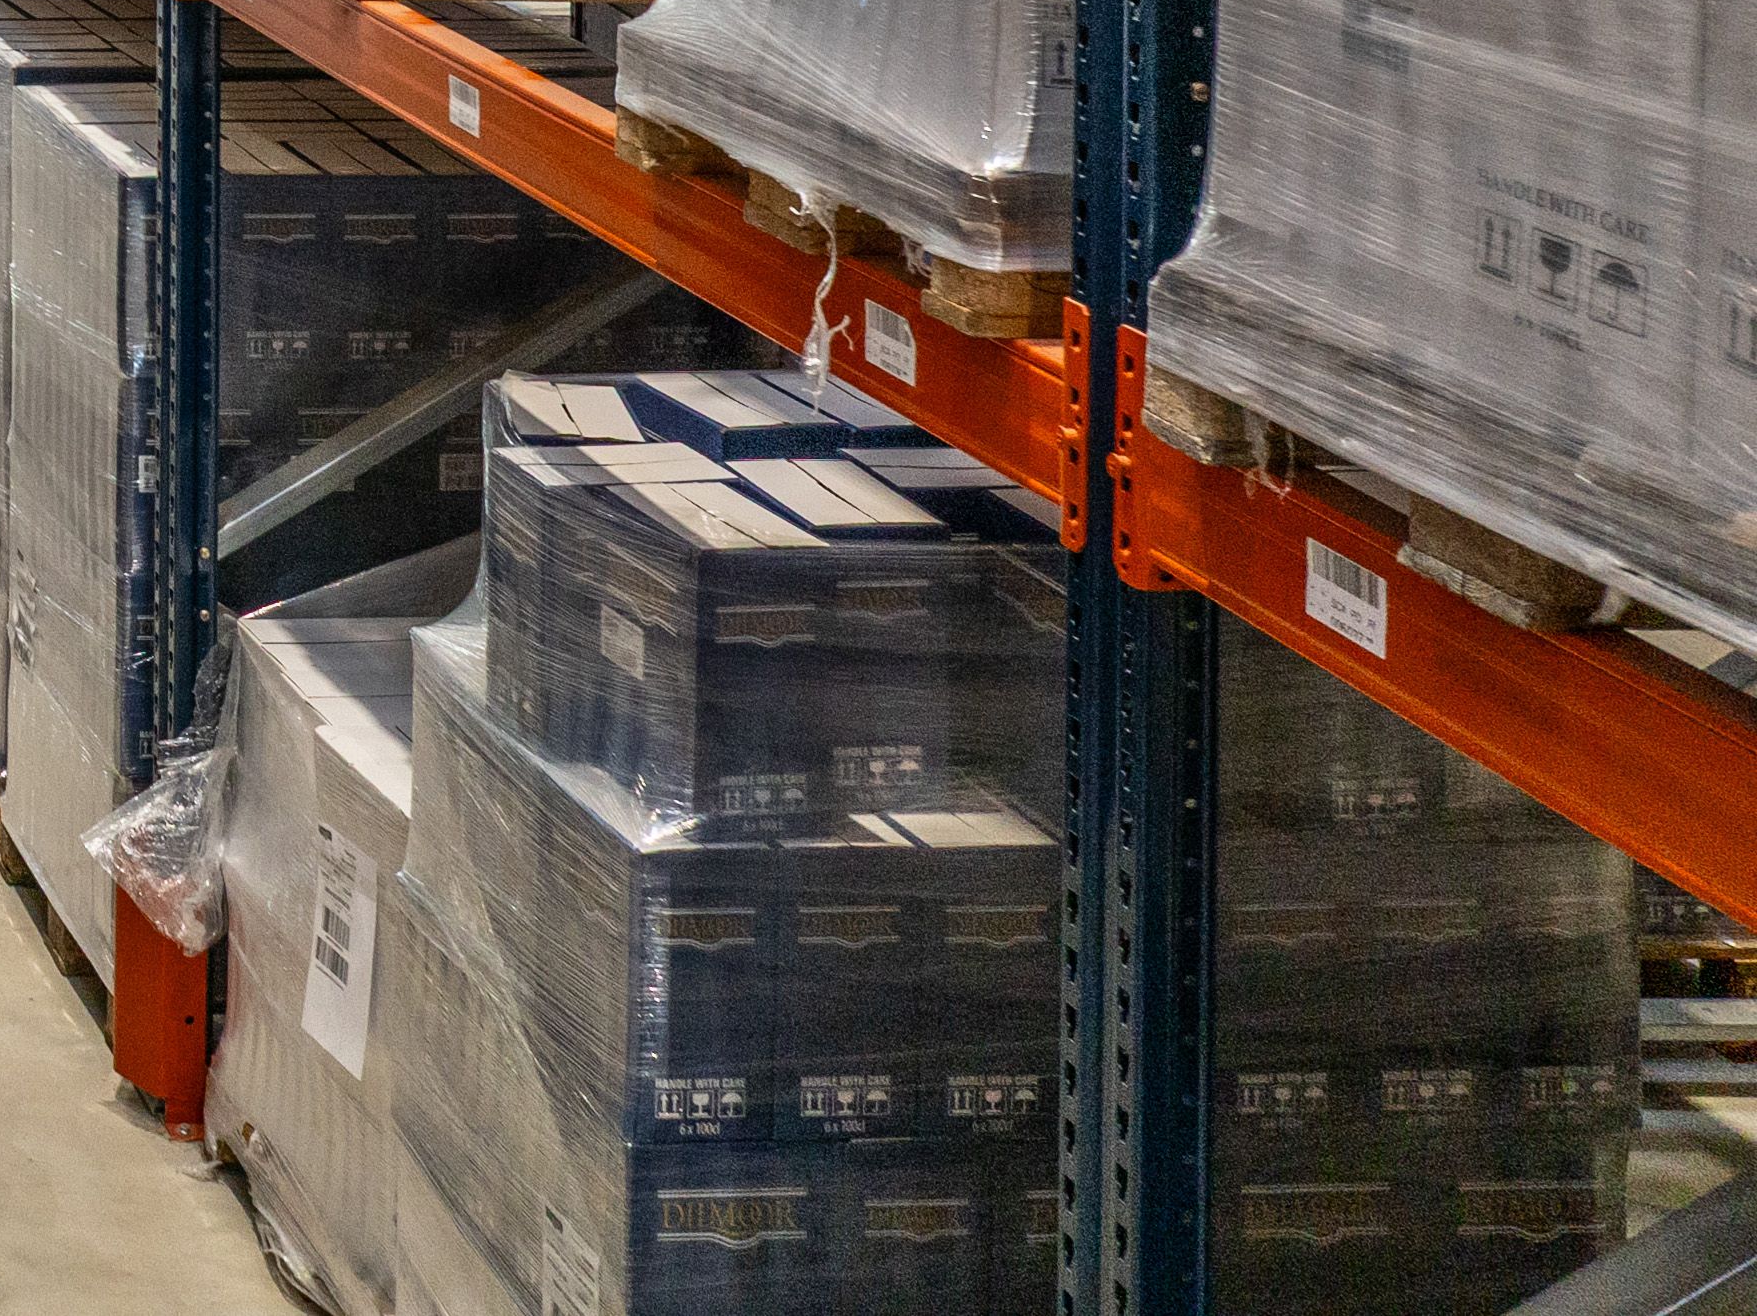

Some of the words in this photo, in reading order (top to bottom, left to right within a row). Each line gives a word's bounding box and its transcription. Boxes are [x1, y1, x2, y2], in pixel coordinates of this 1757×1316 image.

[1600, 210, 1650, 245] CARE
[655, 1078, 693, 1089] HANDLE
[695, 1078, 720, 1088] WITH
[722, 1078, 747, 1088] CARE
[840, 1075, 865, 1086] WITH
